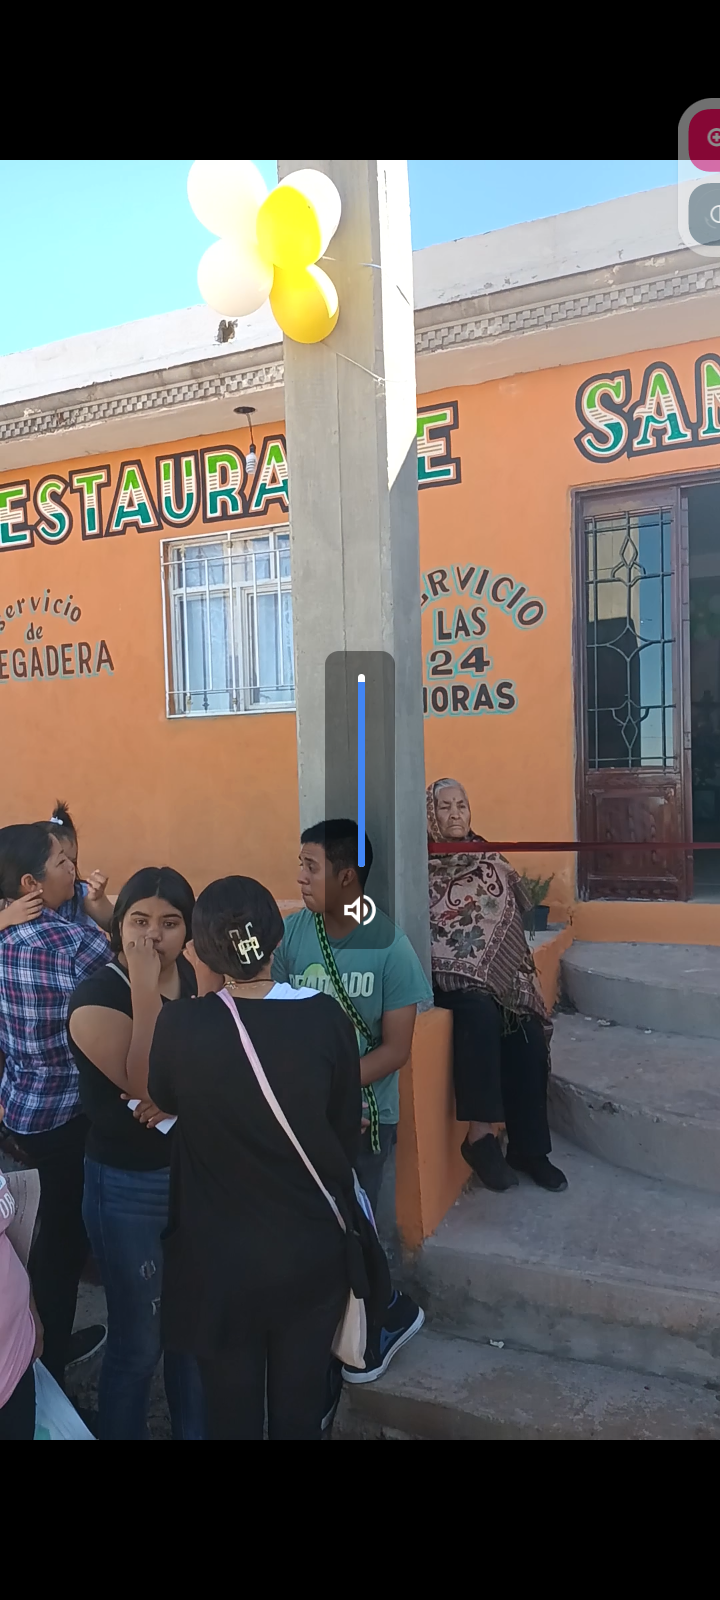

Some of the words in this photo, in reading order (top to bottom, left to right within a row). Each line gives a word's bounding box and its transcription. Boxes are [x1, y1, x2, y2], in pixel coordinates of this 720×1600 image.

[420, 565, 545, 627] RVICIO
[26, 621, 44, 641] de
[436, 605, 487, 641] LAS
[429, 646, 491, 676] 24
